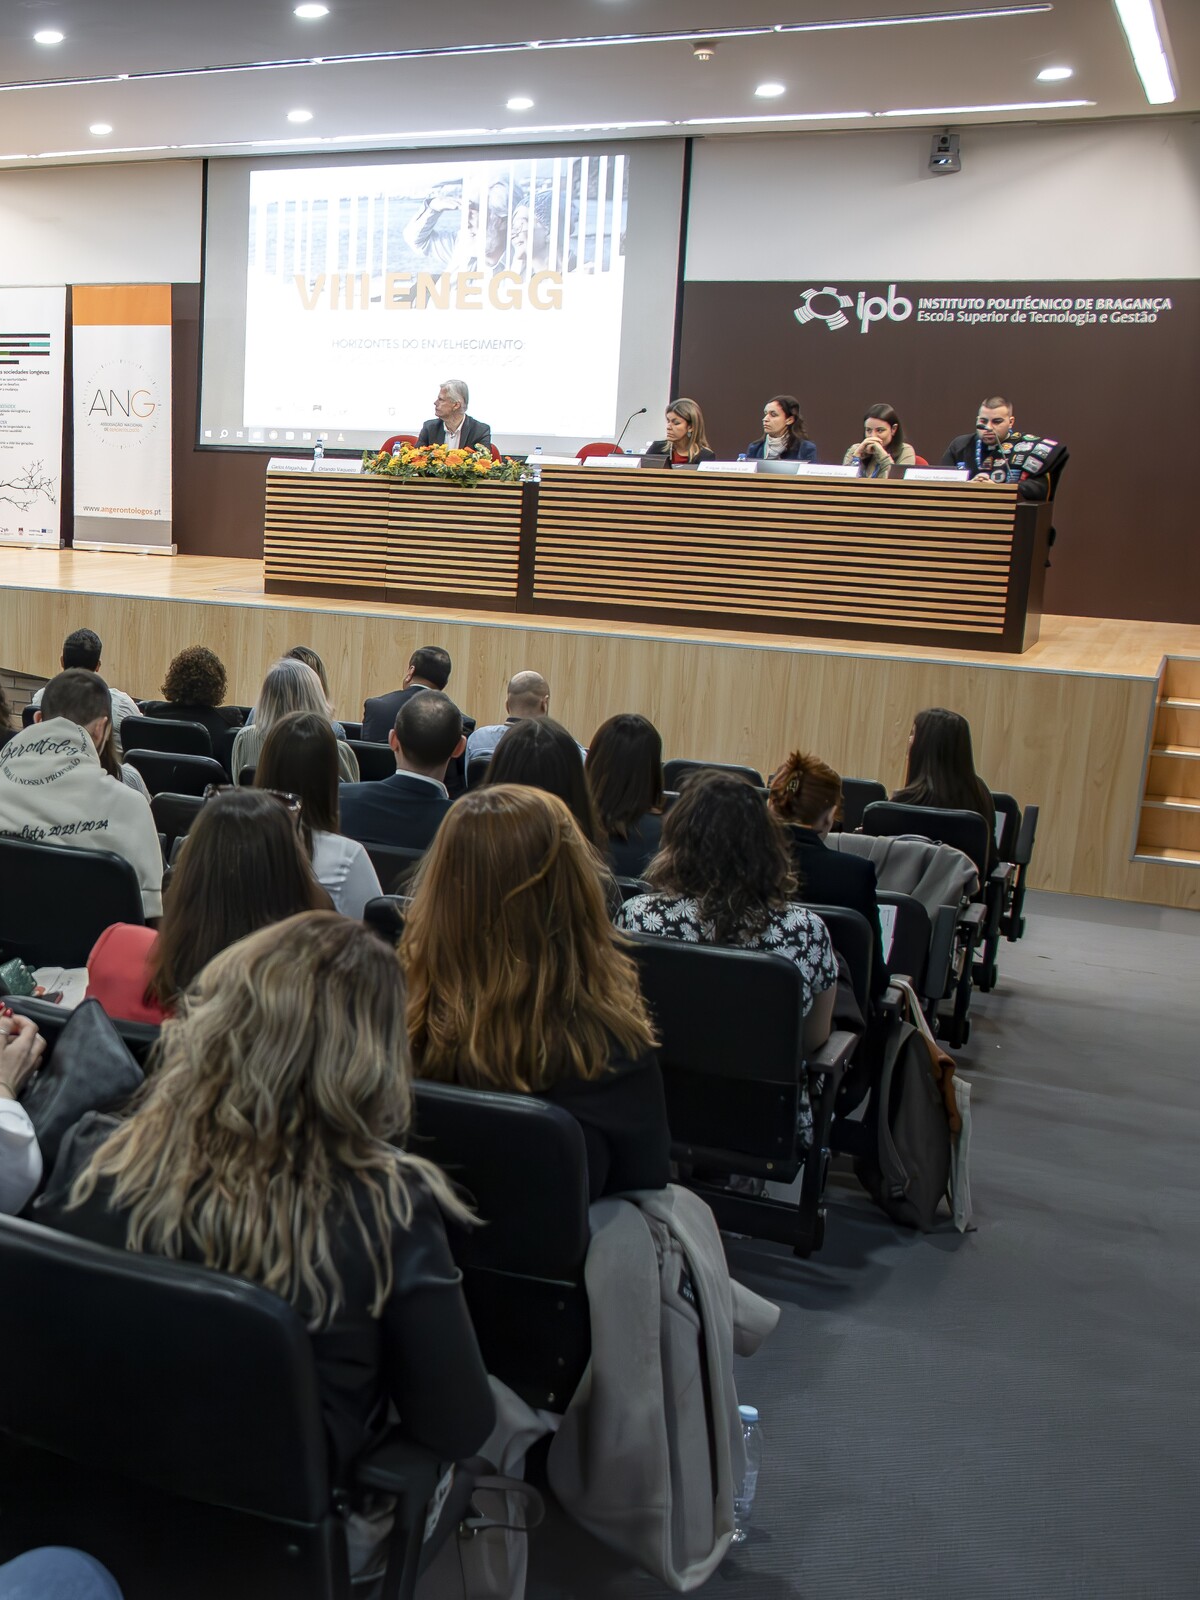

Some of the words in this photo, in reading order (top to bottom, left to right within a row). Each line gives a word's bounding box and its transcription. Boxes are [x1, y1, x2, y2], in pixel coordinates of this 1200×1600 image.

[384, 270, 564, 311] ENEGG
[856, 284, 913, 334] ipb
[918, 298, 984, 310] INSTITUTO
[986, 295, 1073, 310] POLITÉCNICO
[1074, 298, 1094, 310] DE
[1095, 298, 1172, 313] BRAGANÇA
[917, 310, 954, 322] Escola
[956, 311, 1009, 325] Superior
[1010, 311, 1027, 323] de
[1028, 311, 1097, 327] Tecnologia
[1099, 313, 1108, 323] e
[1110, 311, 1158, 323] Gestão
[332, 338, 400, 349] HORIZONTES
[402, 338, 419, 349] DO
[89, 389, 156, 418] ANG
[83, 505, 162, 516] www.angerontologos.pt
[19, 778, 45, 786] NOSSA
